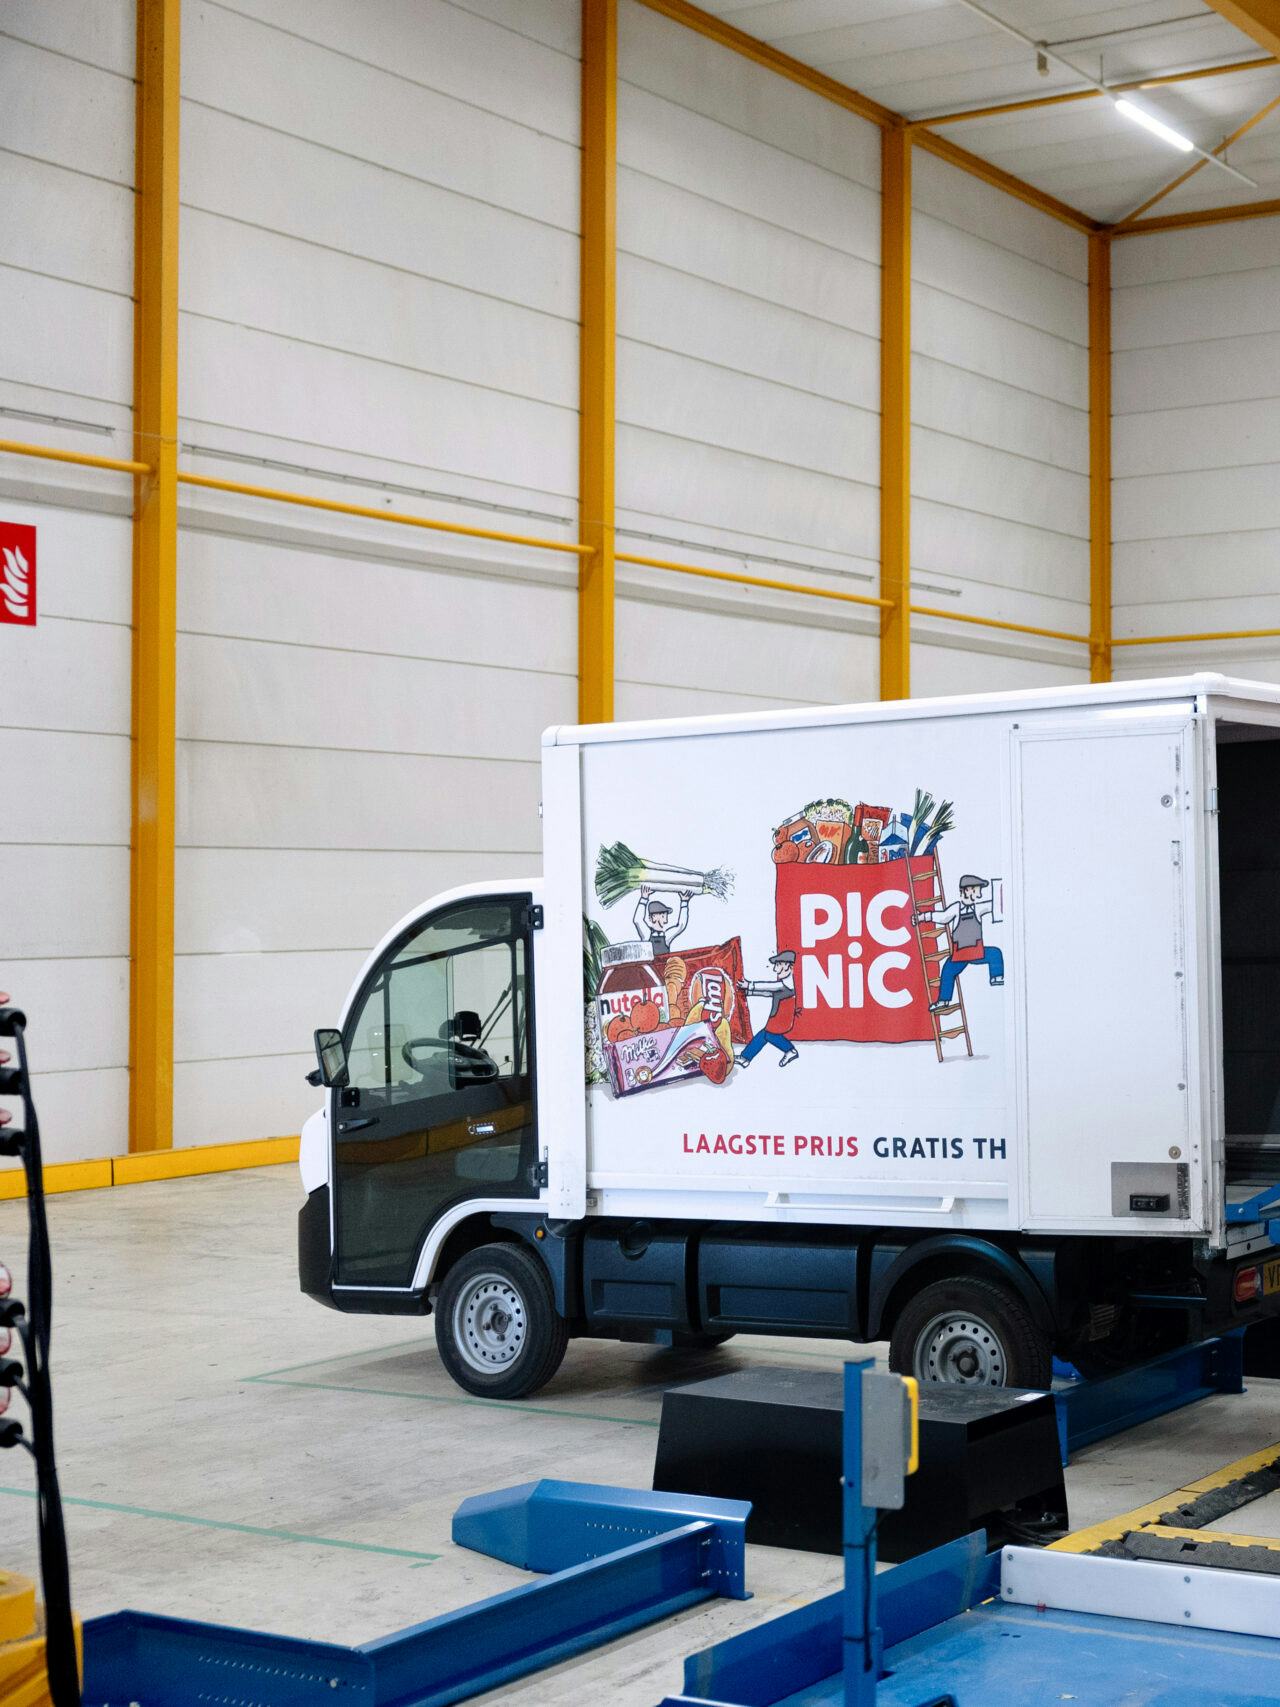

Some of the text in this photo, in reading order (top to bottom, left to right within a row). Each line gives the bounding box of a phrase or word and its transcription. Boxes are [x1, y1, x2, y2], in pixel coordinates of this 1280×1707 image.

[798, 889, 911, 949] PIC
[621, 1036, 658, 1064] Milka
[683, 1133, 1007, 1159] LAAGSTE PRIJS GRATIS TH
